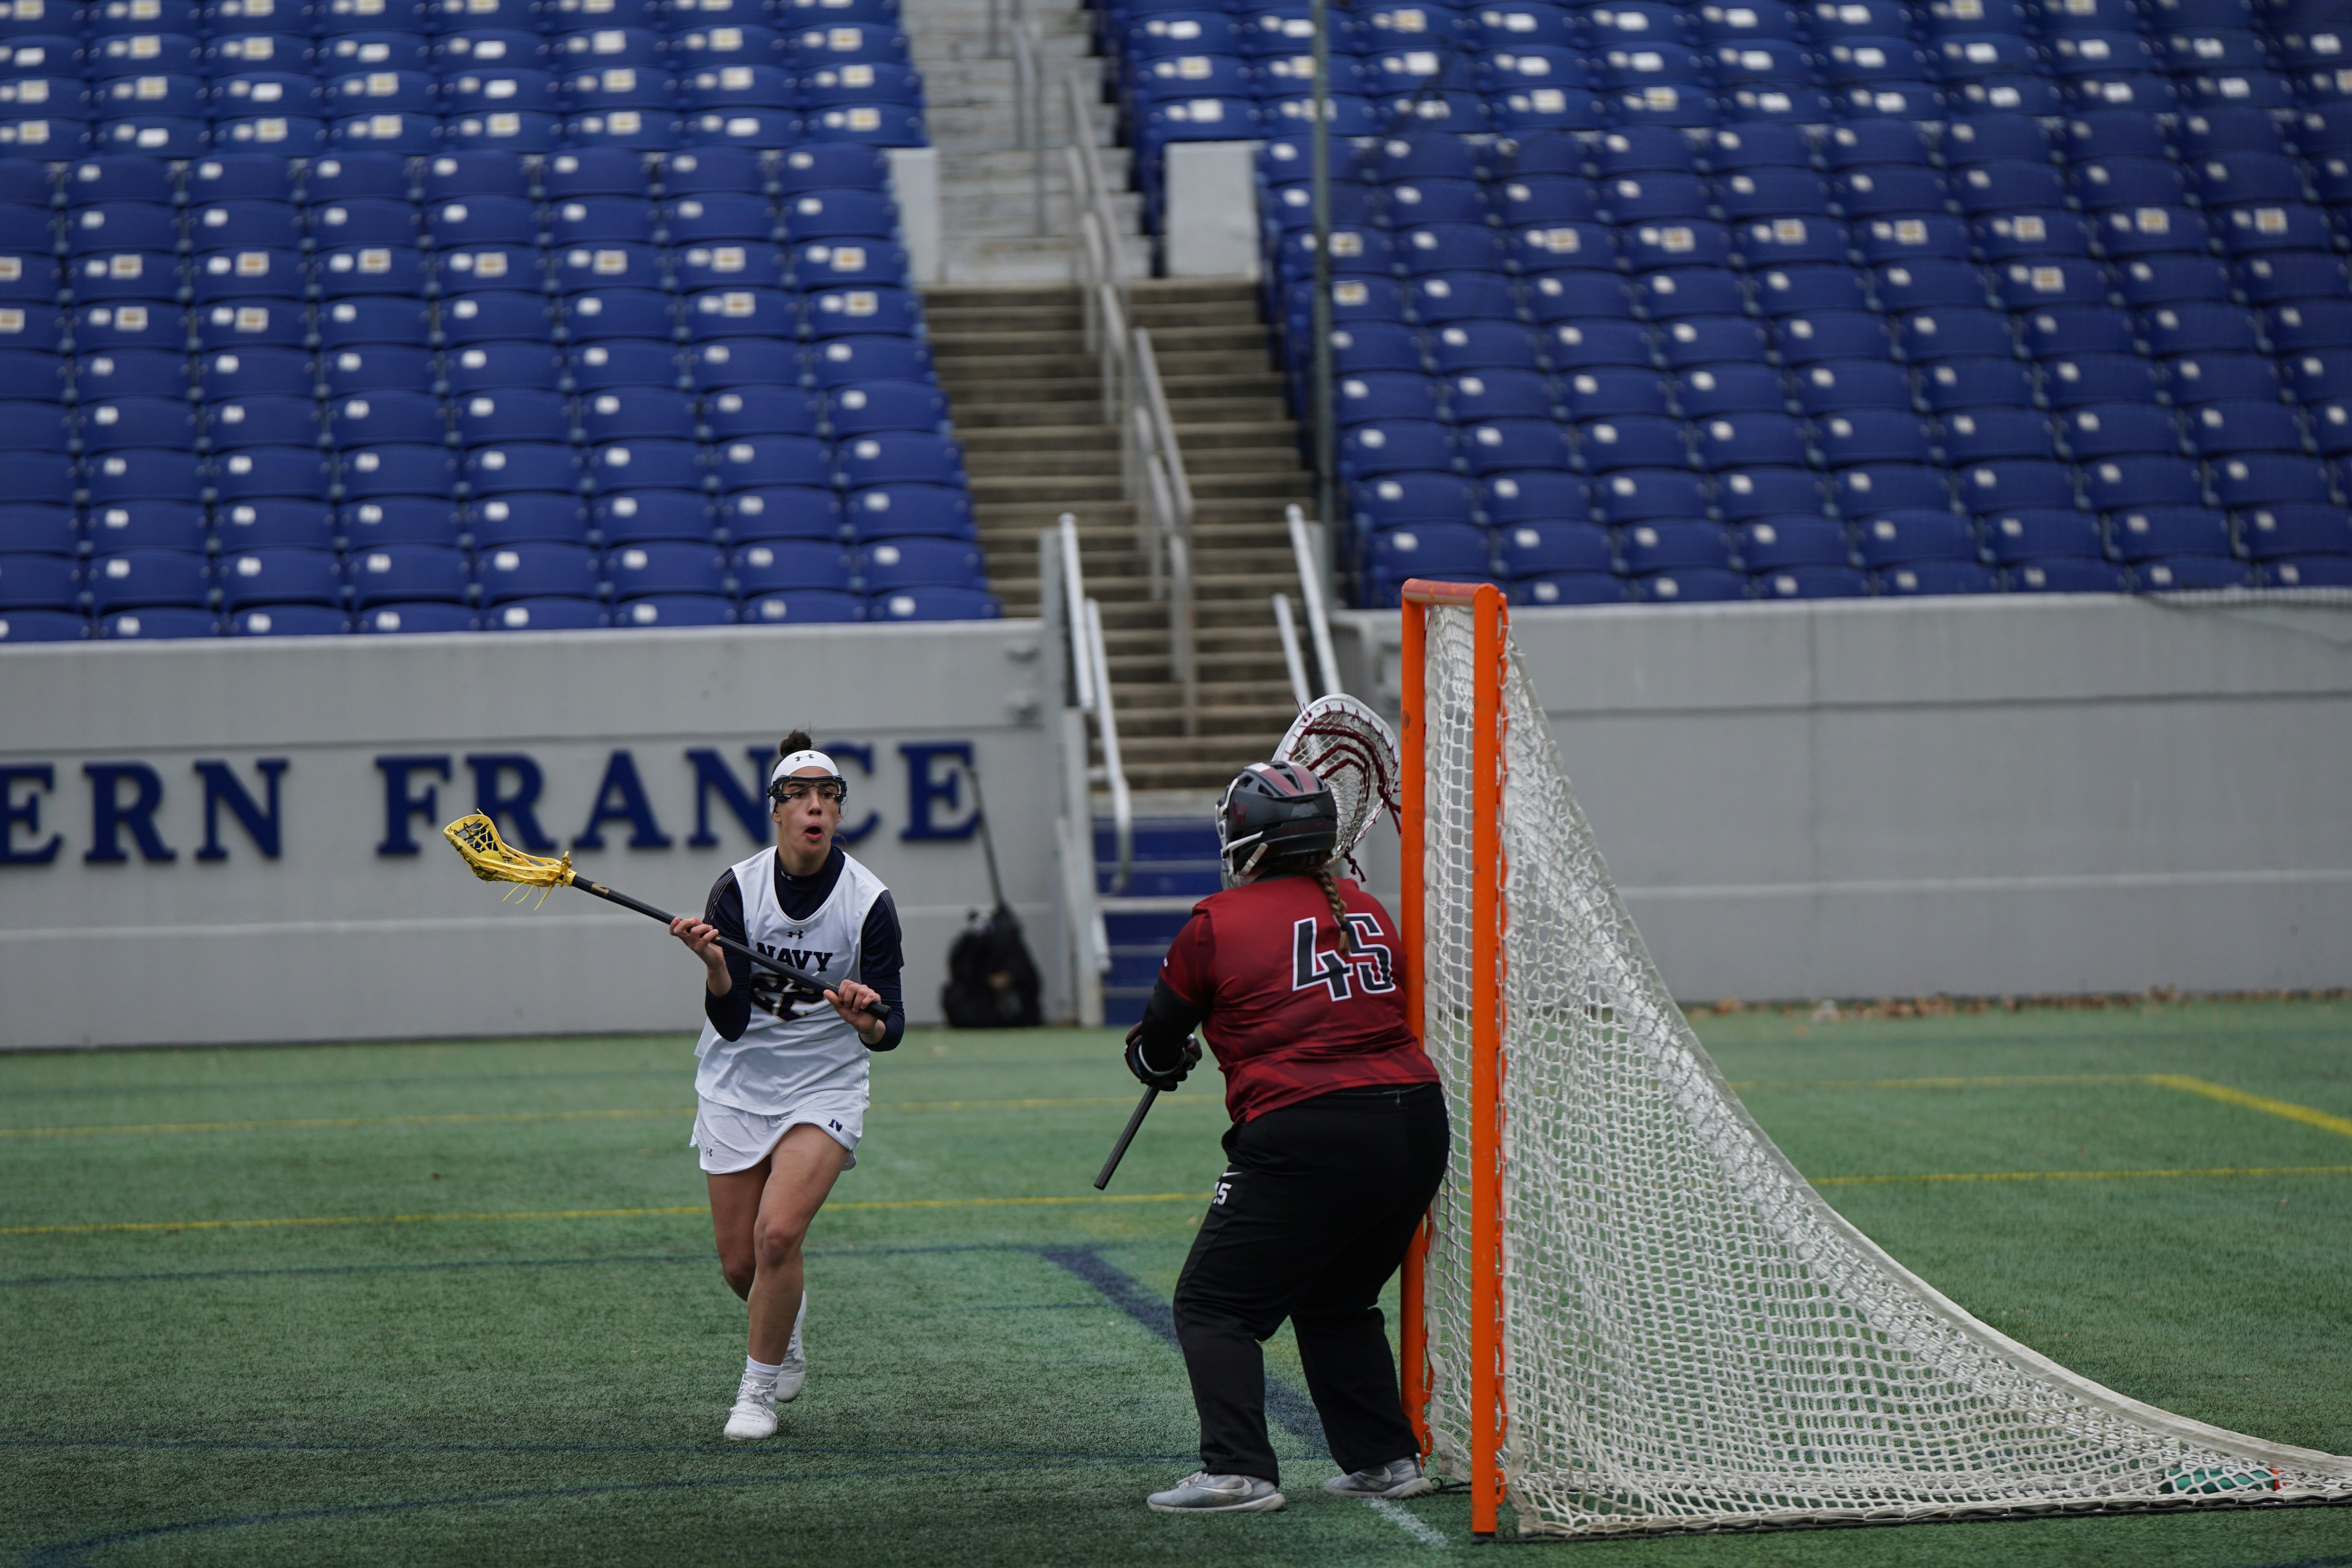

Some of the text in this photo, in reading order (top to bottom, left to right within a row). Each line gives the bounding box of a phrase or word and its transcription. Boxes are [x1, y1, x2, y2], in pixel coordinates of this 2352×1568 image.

[0, 759, 289, 862] ERN
[757, 942, 833, 972] NAVY
[1292, 913, 1396, 1002] 45
